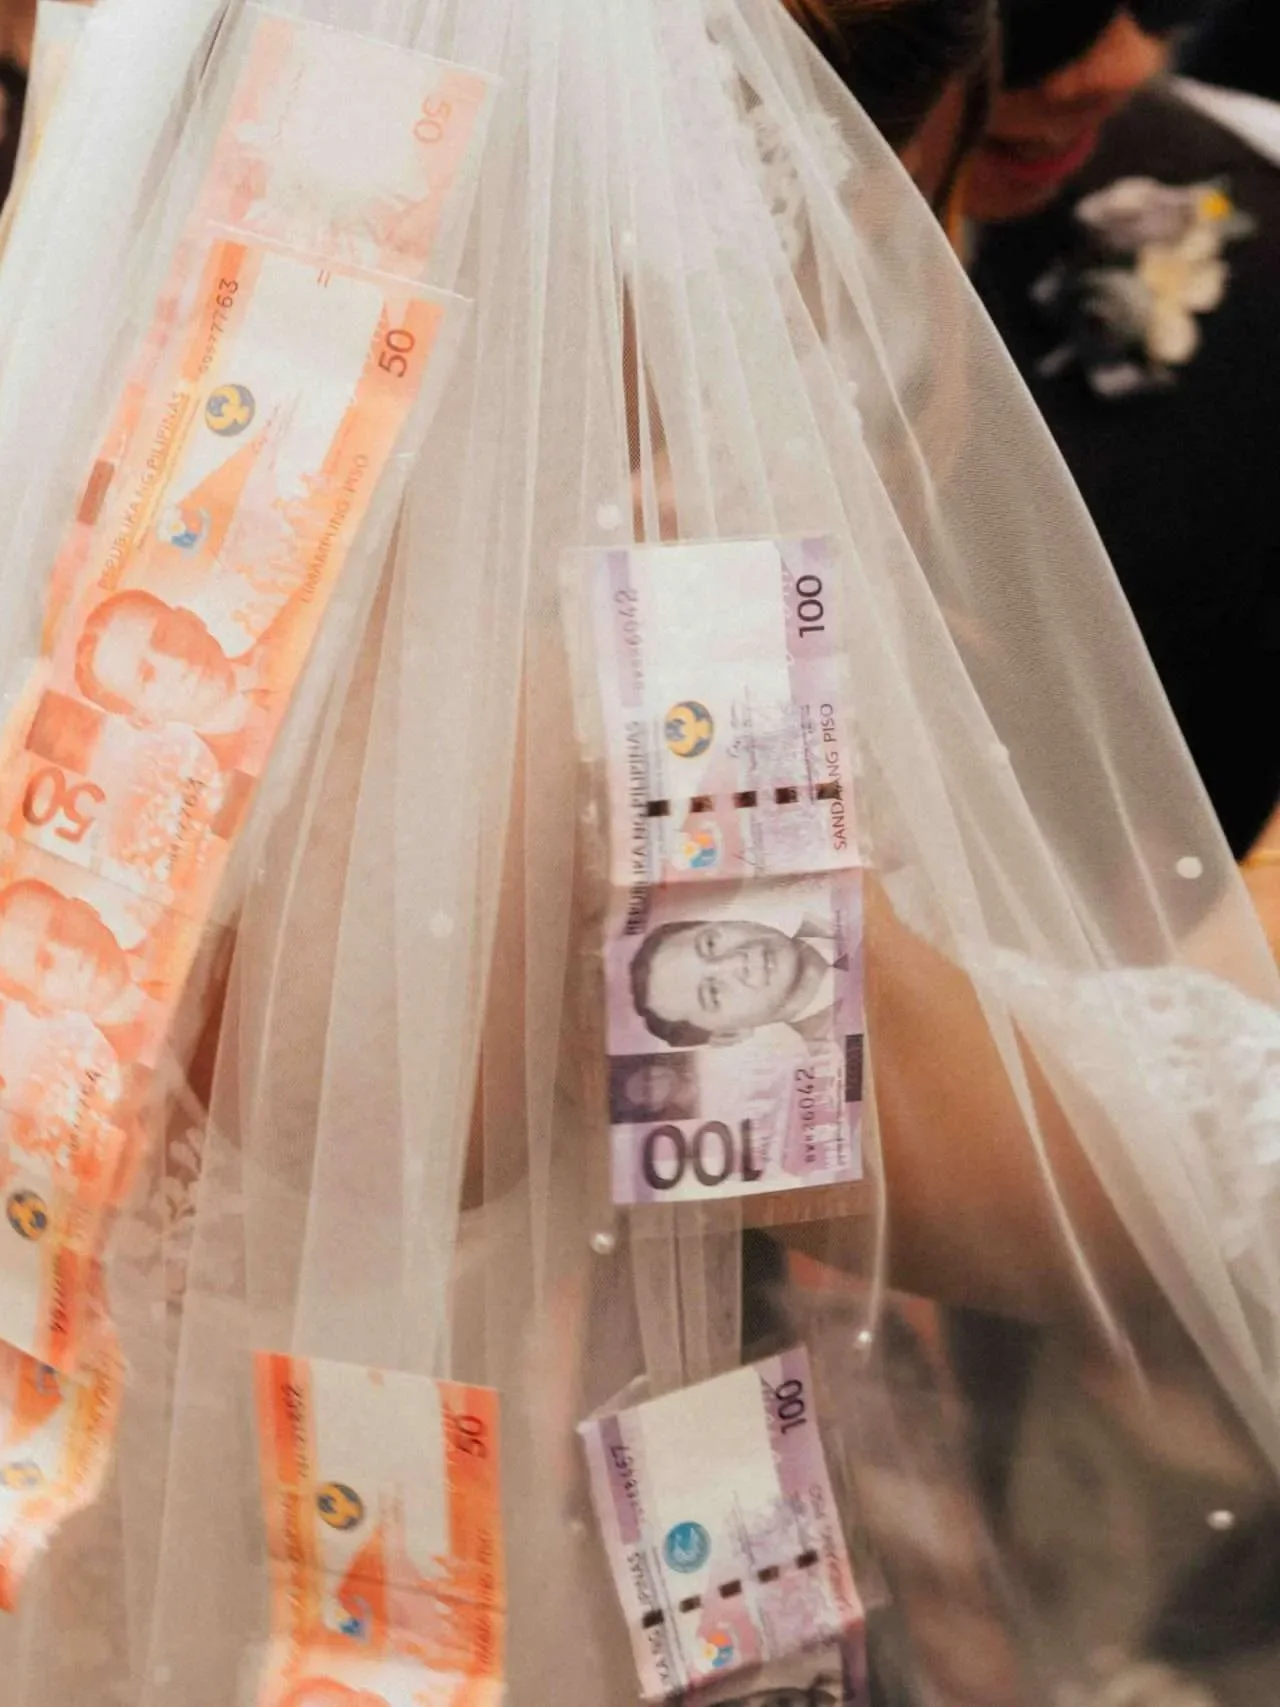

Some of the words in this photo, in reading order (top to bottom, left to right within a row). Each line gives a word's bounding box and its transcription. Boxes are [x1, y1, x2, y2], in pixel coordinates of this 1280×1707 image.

[413, 98, 452, 144] 50
[379, 328, 416, 379] 50
[796, 575, 825, 638] 100
[820, 703, 836, 743] PISO
[22, 767, 106, 843] 50
[826, 751, 847, 850] SANDAANG
[642, 1118, 764, 1190] 100
[775, 1379, 807, 1435] 100
[454, 1415, 486, 1459] 50
